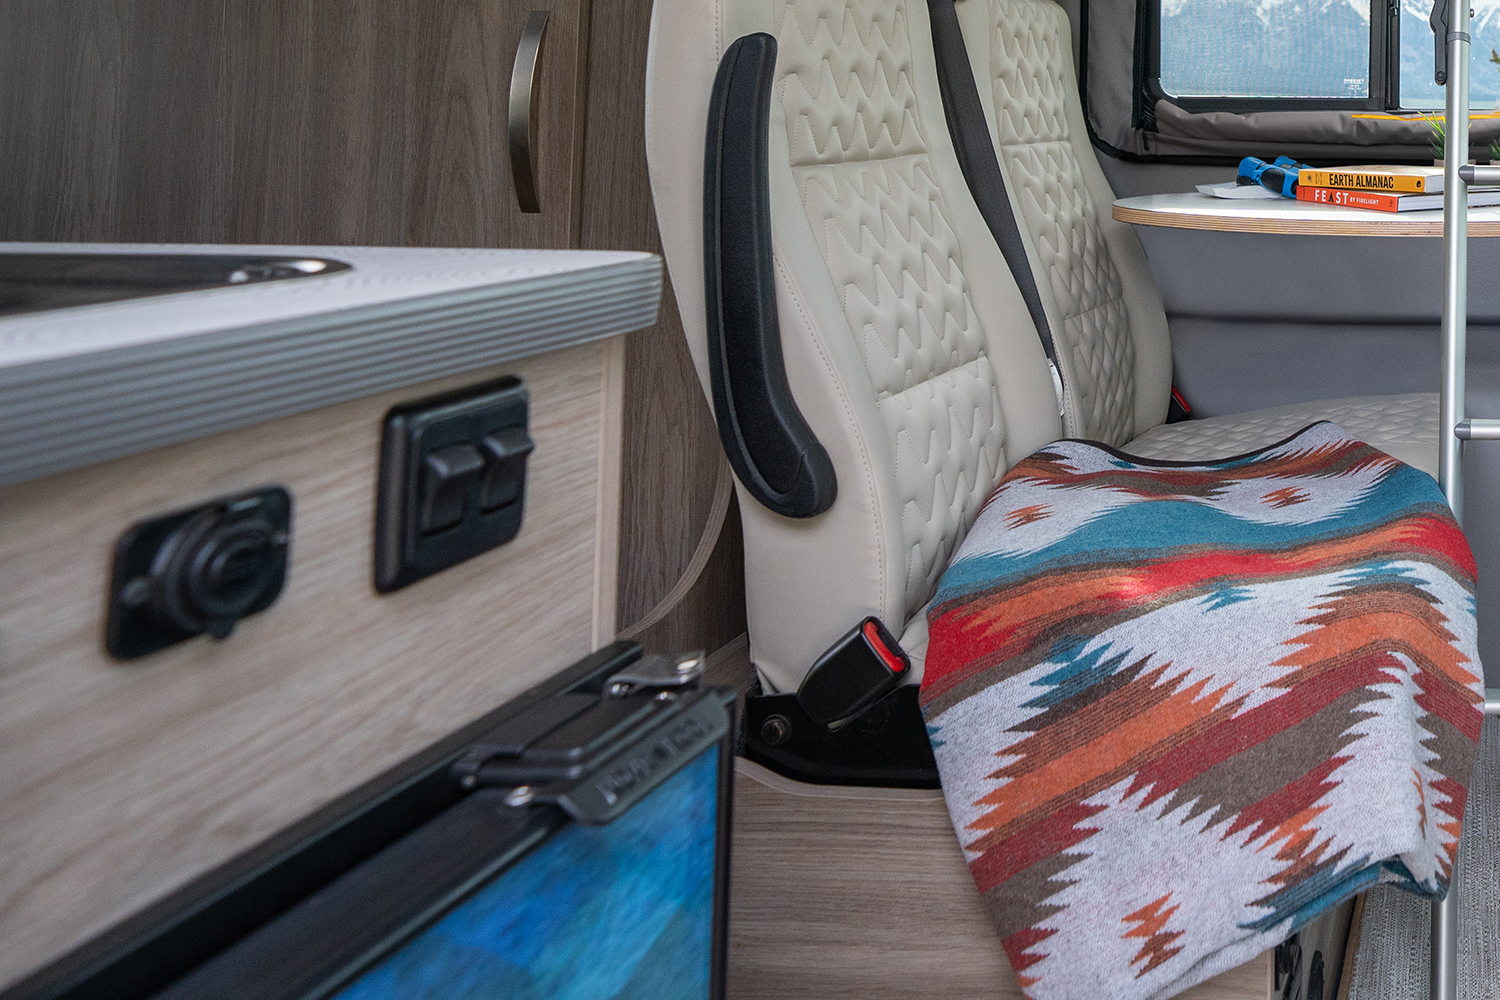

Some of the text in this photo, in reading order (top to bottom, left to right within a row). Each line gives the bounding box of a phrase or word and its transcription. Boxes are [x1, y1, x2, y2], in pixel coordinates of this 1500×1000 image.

[1329, 174, 1354, 187] EARTH
[1355, 175, 1394, 189] ALMANAC
[1314, 189, 1349, 205] FEAST
[1356, 197, 1380, 206] FIRELIGHT
